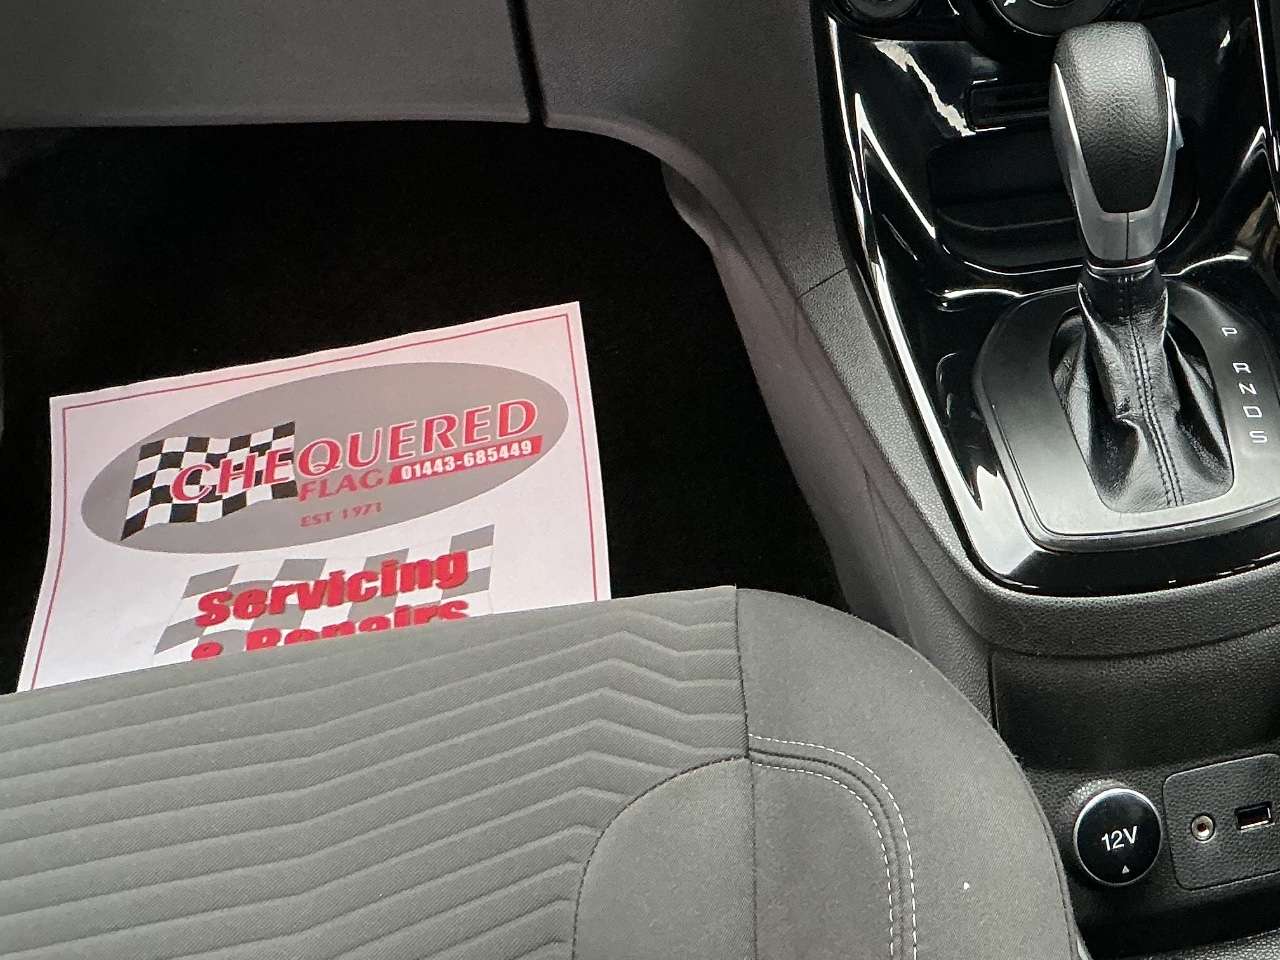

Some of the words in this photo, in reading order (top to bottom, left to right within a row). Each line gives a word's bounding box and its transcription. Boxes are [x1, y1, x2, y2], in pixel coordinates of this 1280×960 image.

[1221, 326, 1238, 337] P
[1232, 361, 1252, 375] R
[1238, 383, 1257, 396] N
[1242, 405, 1263, 419] D
[1249, 430, 1269, 444] S
[169, 398, 539, 504] CHEQUERED
[400, 439, 533, 481] 01443-685449
[297, 467, 385, 503] FLAG
[299, 511, 333, 528] EST
[194, 549, 470, 628] Servicing
[1101, 826, 1138, 850] 12V
